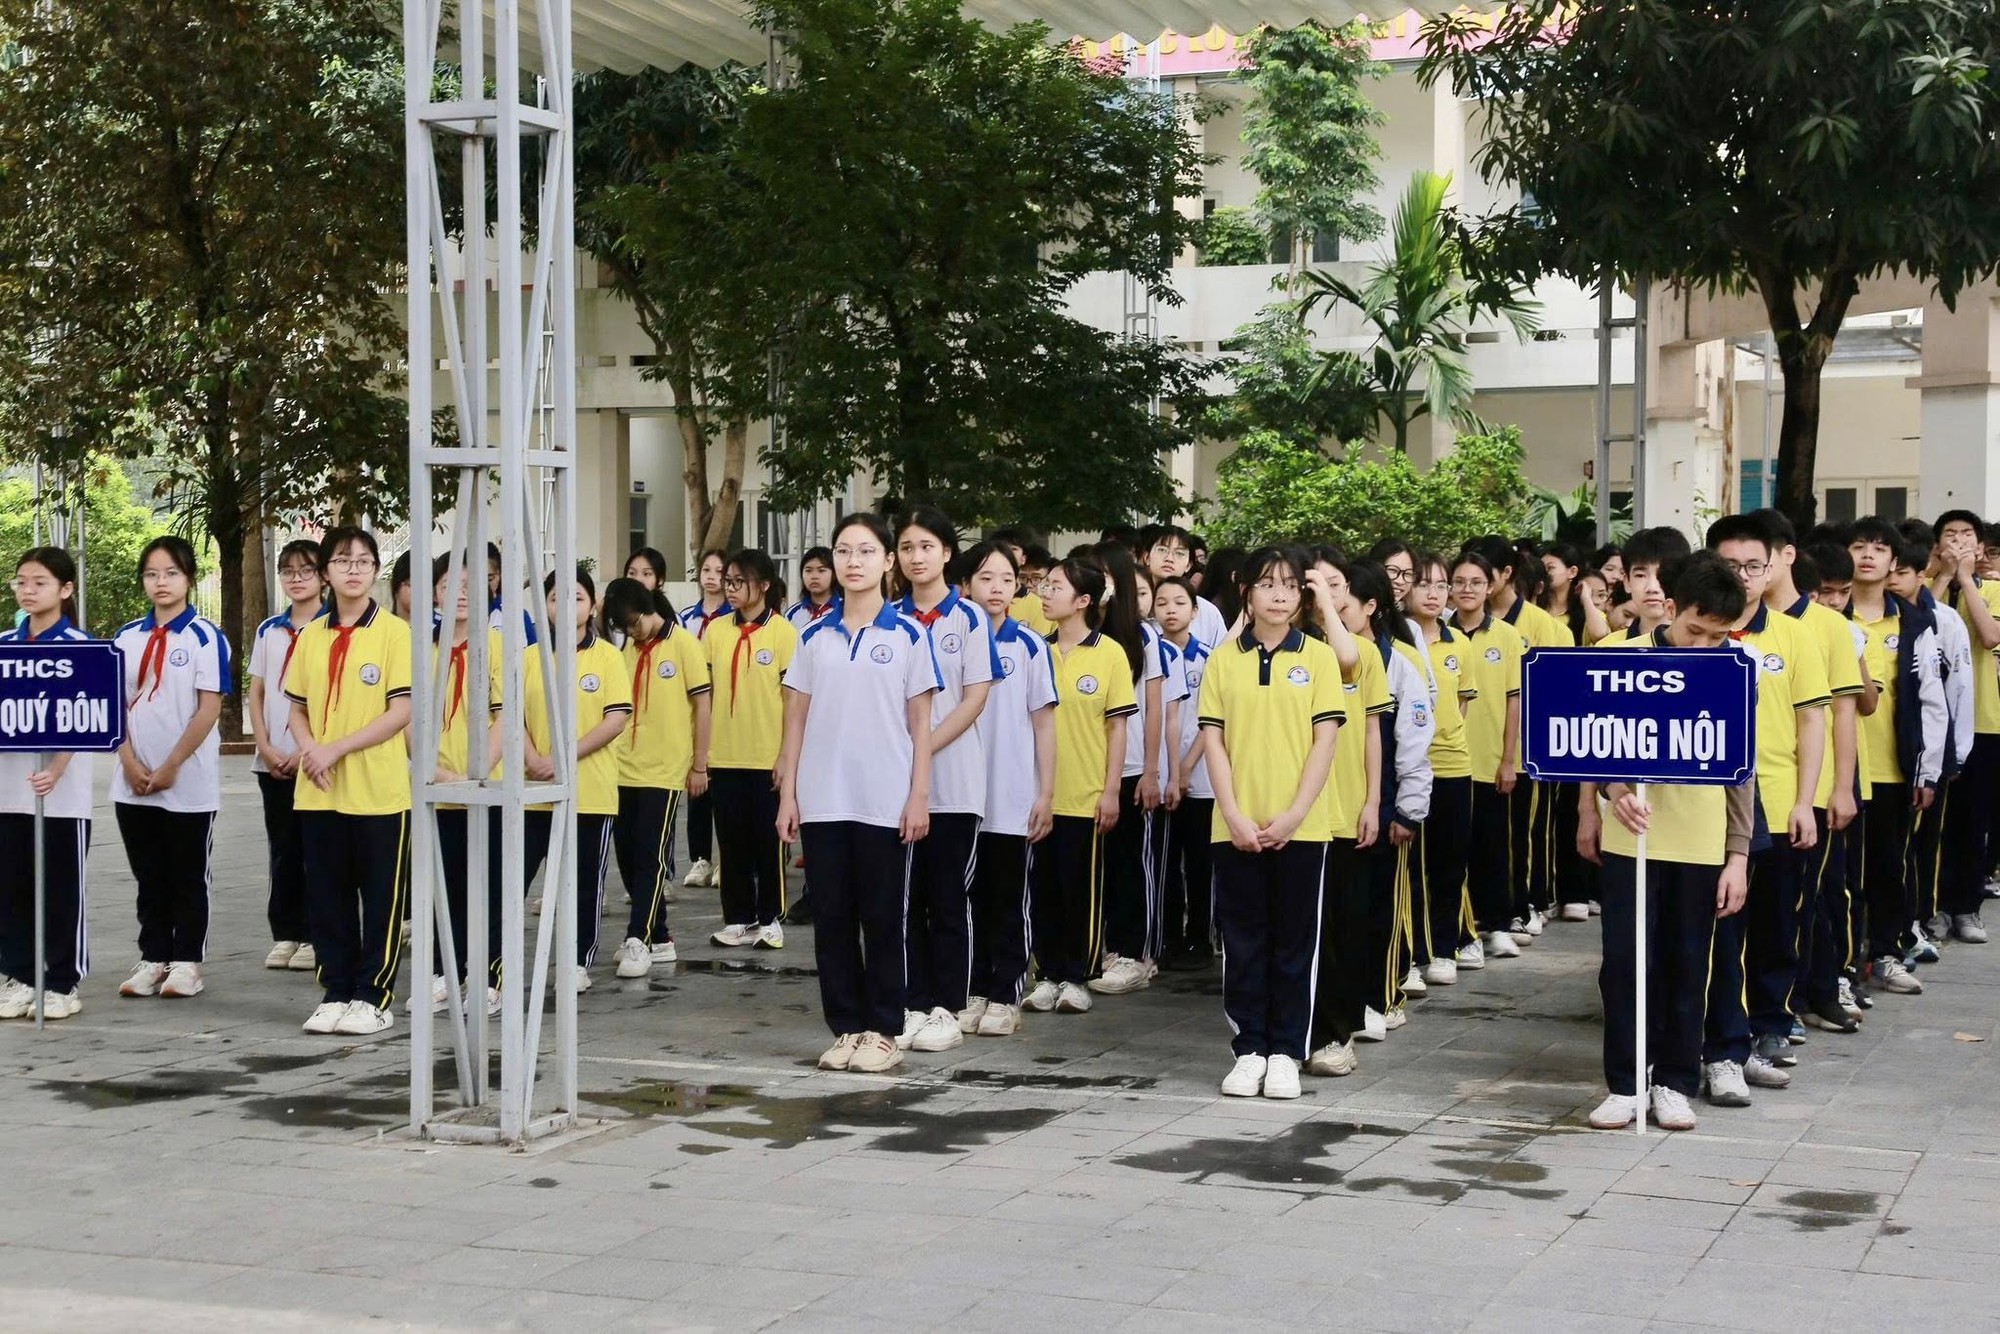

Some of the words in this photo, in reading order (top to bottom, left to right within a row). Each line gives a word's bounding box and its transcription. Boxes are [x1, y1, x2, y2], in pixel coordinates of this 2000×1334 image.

[0, 659, 74, 679] THCS
[1586, 670, 1686, 693] THCS
[0, 691, 49, 738] QUÝ
[55, 691, 109, 734] ĐÔN
[1548, 713, 1658, 760] DƯƠNG
[1669, 710, 1726, 770] NỘI
